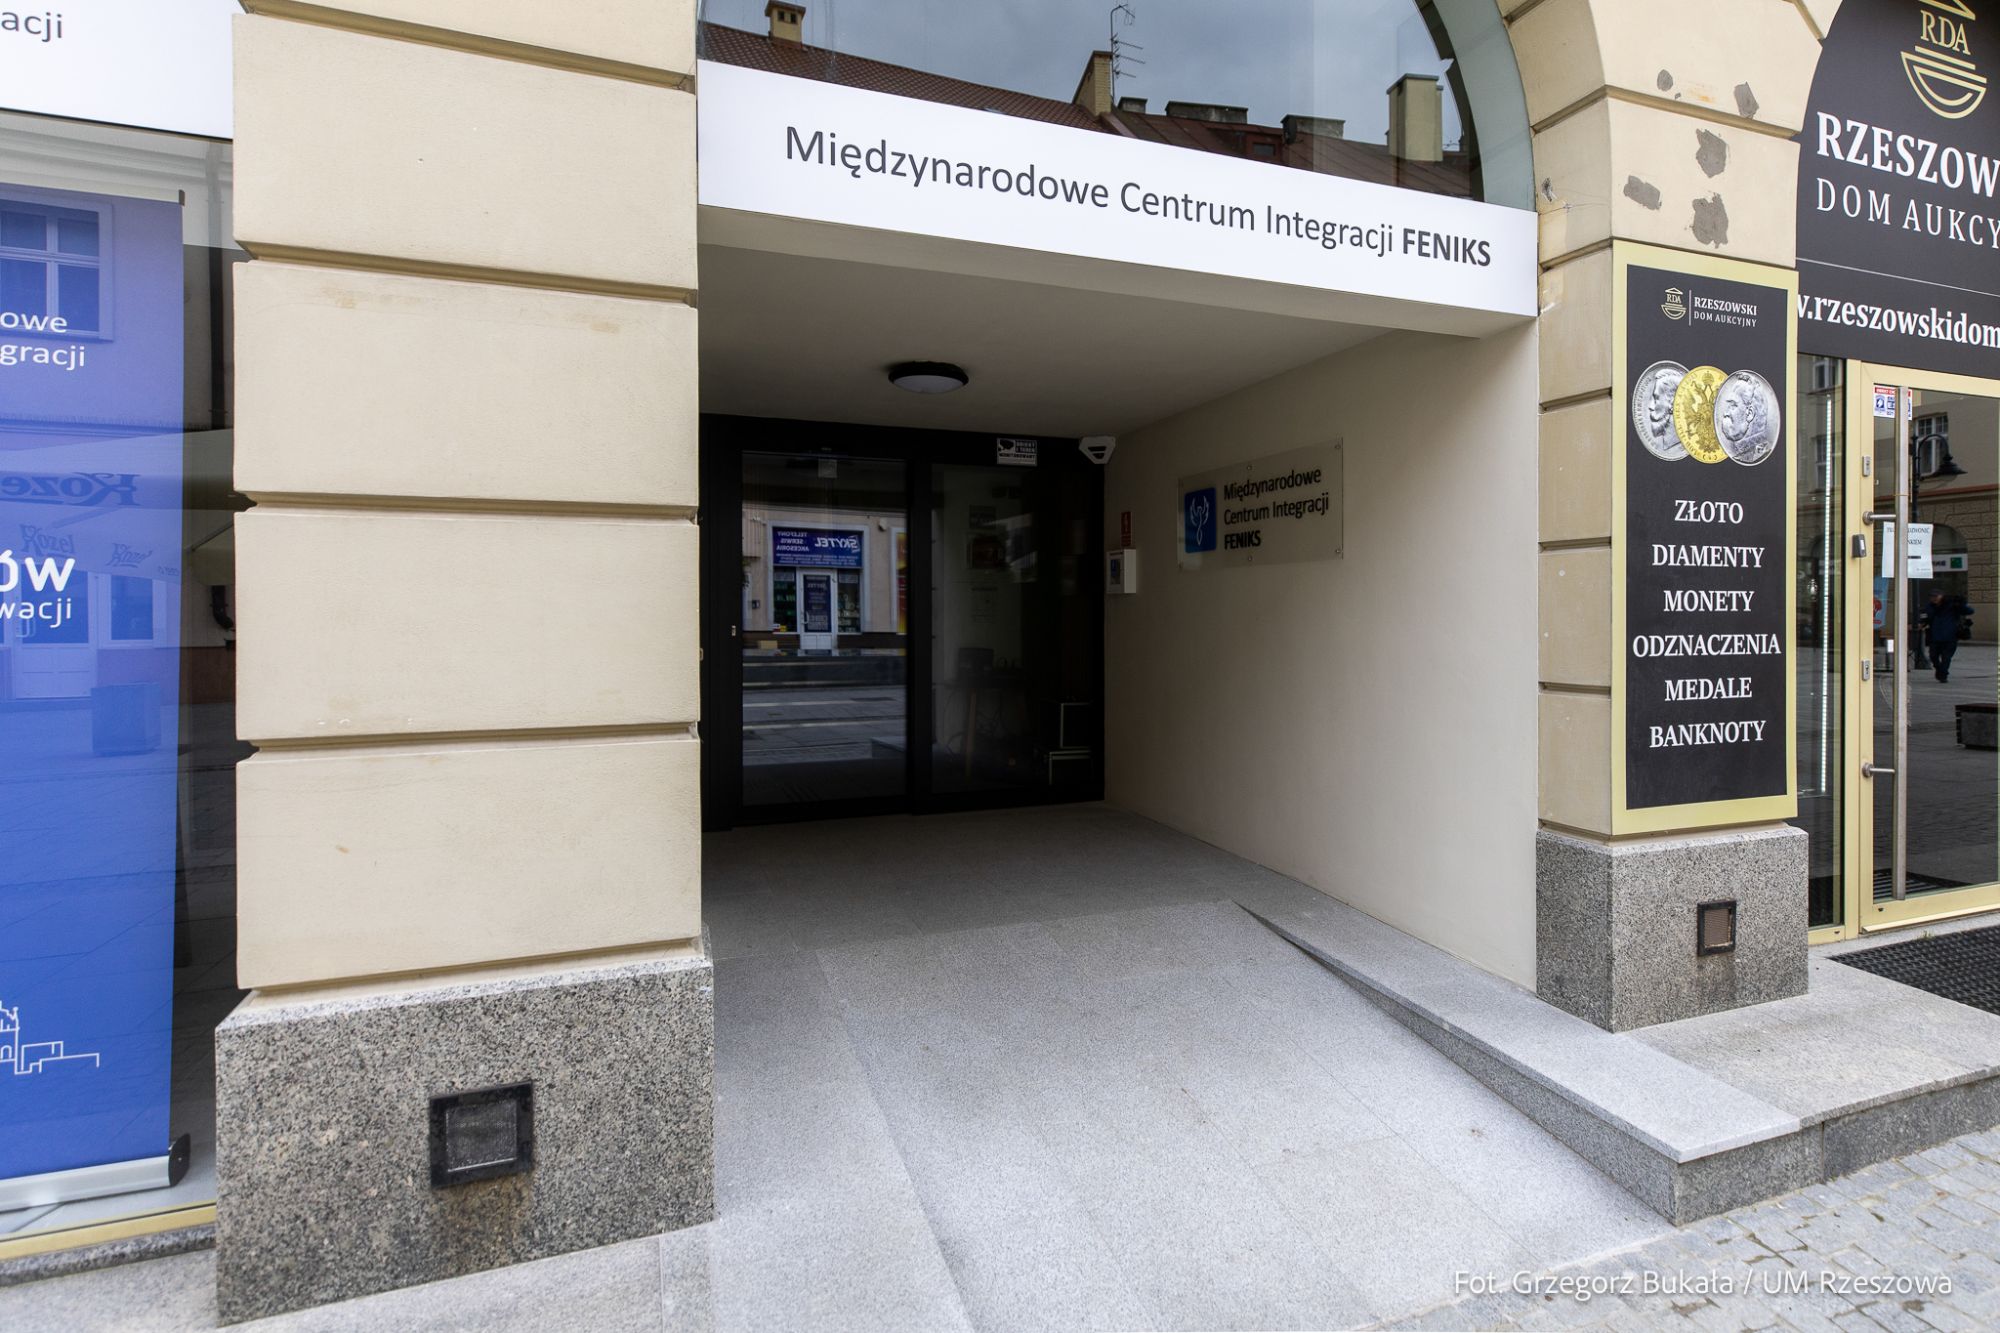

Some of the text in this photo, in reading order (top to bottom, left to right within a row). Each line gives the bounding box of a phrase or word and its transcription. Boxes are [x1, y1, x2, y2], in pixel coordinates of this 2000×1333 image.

[1, 11, 62, 43] acji
[1920, 9, 1971, 56] RDA
[1817, 111, 2000, 198] RZESZOW
[786, 126, 1491, 267] Międzynarodowe Centrum Integracji FENIKS
[1816, 177, 1891, 226] DOM
[1666, 293, 1682, 304] RDA
[1694, 296, 1757, 316] RZESZOWSKI
[0, 311, 68, 333] owe
[1694, 311, 1757, 327] DOM AUKCYJNY
[0, 344, 86, 371] gracji
[1224, 468, 1322, 502] Międzynarodowe
[1223, 492, 1329, 526] Centrum Integracji
[1674, 500, 1744, 524] ZŁOTO
[1223, 530, 1262, 550] FENIKS
[1652, 544, 1765, 568] DIAMENTY
[1663, 590, 1754, 612] MONETY
[1633, 633, 1781, 657] ODZNACZENIA
[1664, 677, 1752, 701] MEDALE
[1649, 720, 1766, 748] BANKNOTY
